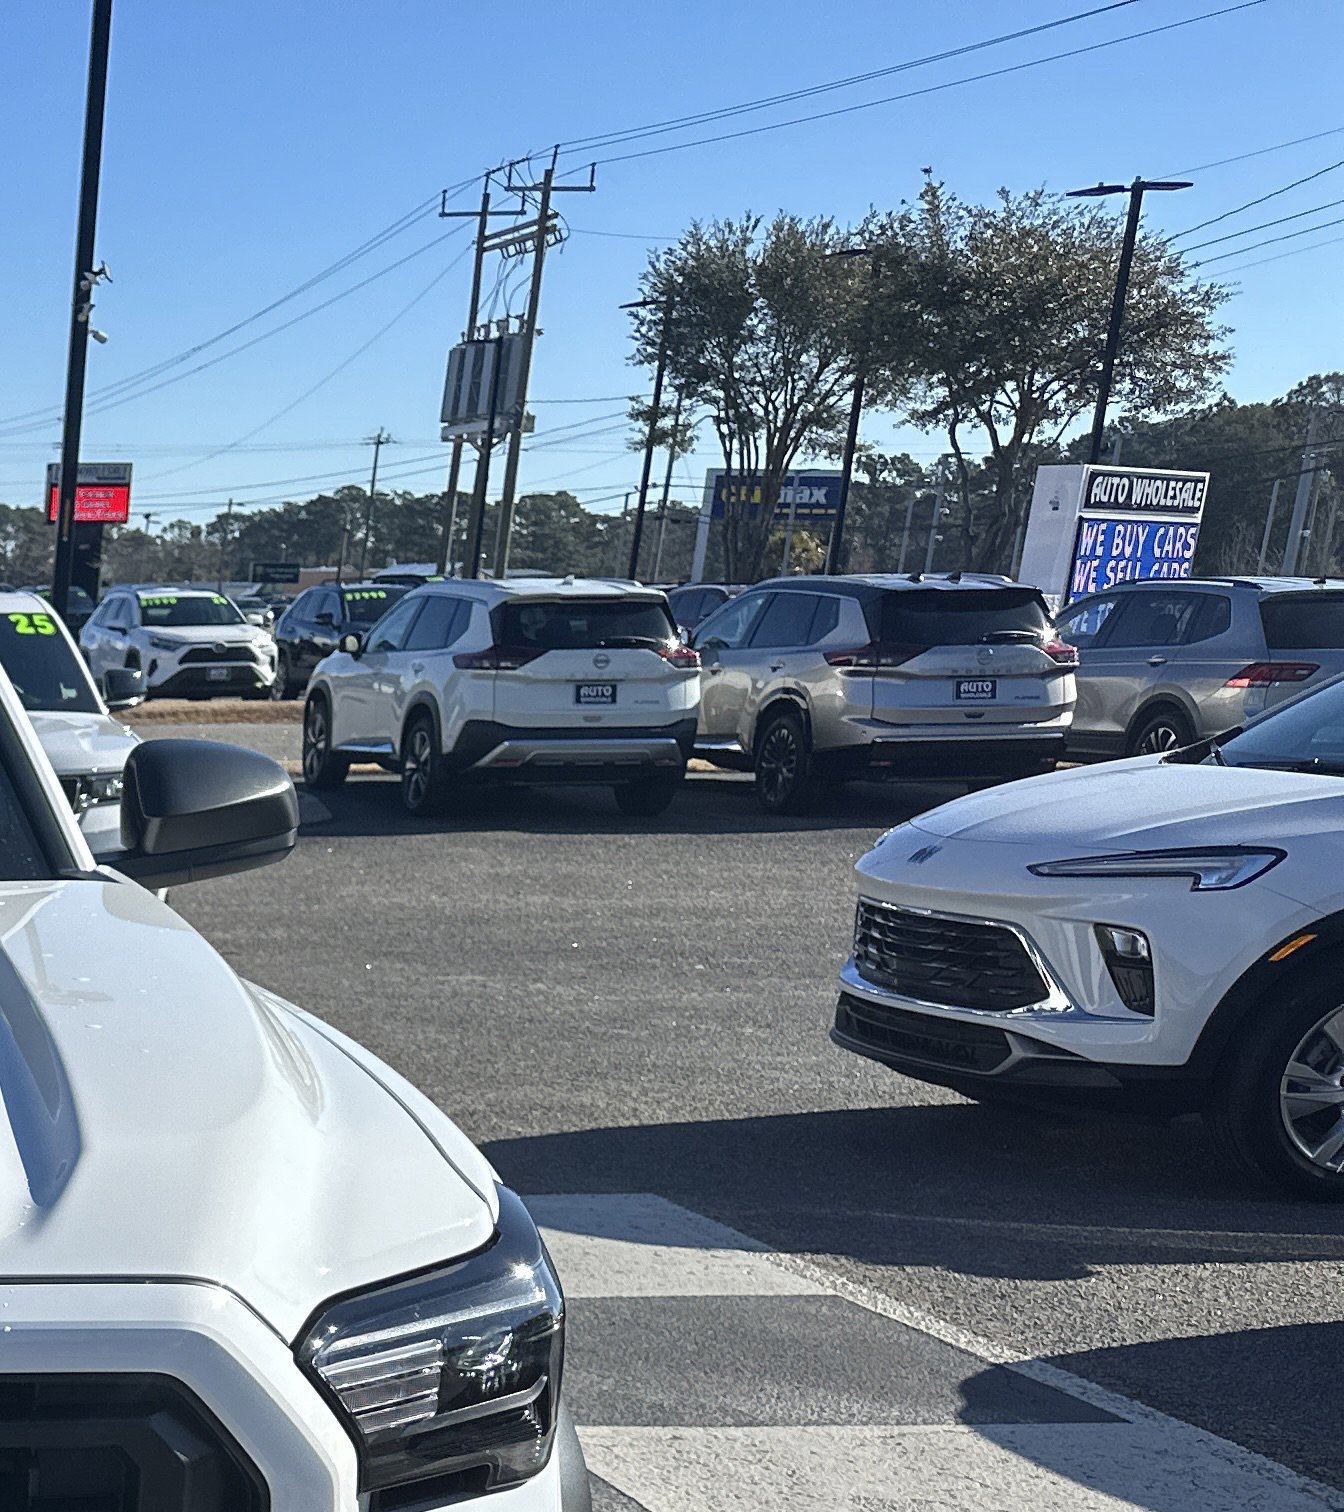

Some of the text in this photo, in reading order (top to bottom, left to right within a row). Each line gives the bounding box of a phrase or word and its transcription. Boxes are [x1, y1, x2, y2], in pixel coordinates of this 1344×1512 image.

[1090, 476, 1204, 510] AUTO WHOLESALE
[1079, 521, 1197, 559] WE BUY CARS
[1073, 558, 1098, 593] WE
[8, 612, 58, 637] 25
[580, 686, 612, 697] AUTO
[960, 681, 992, 692] AUTO
